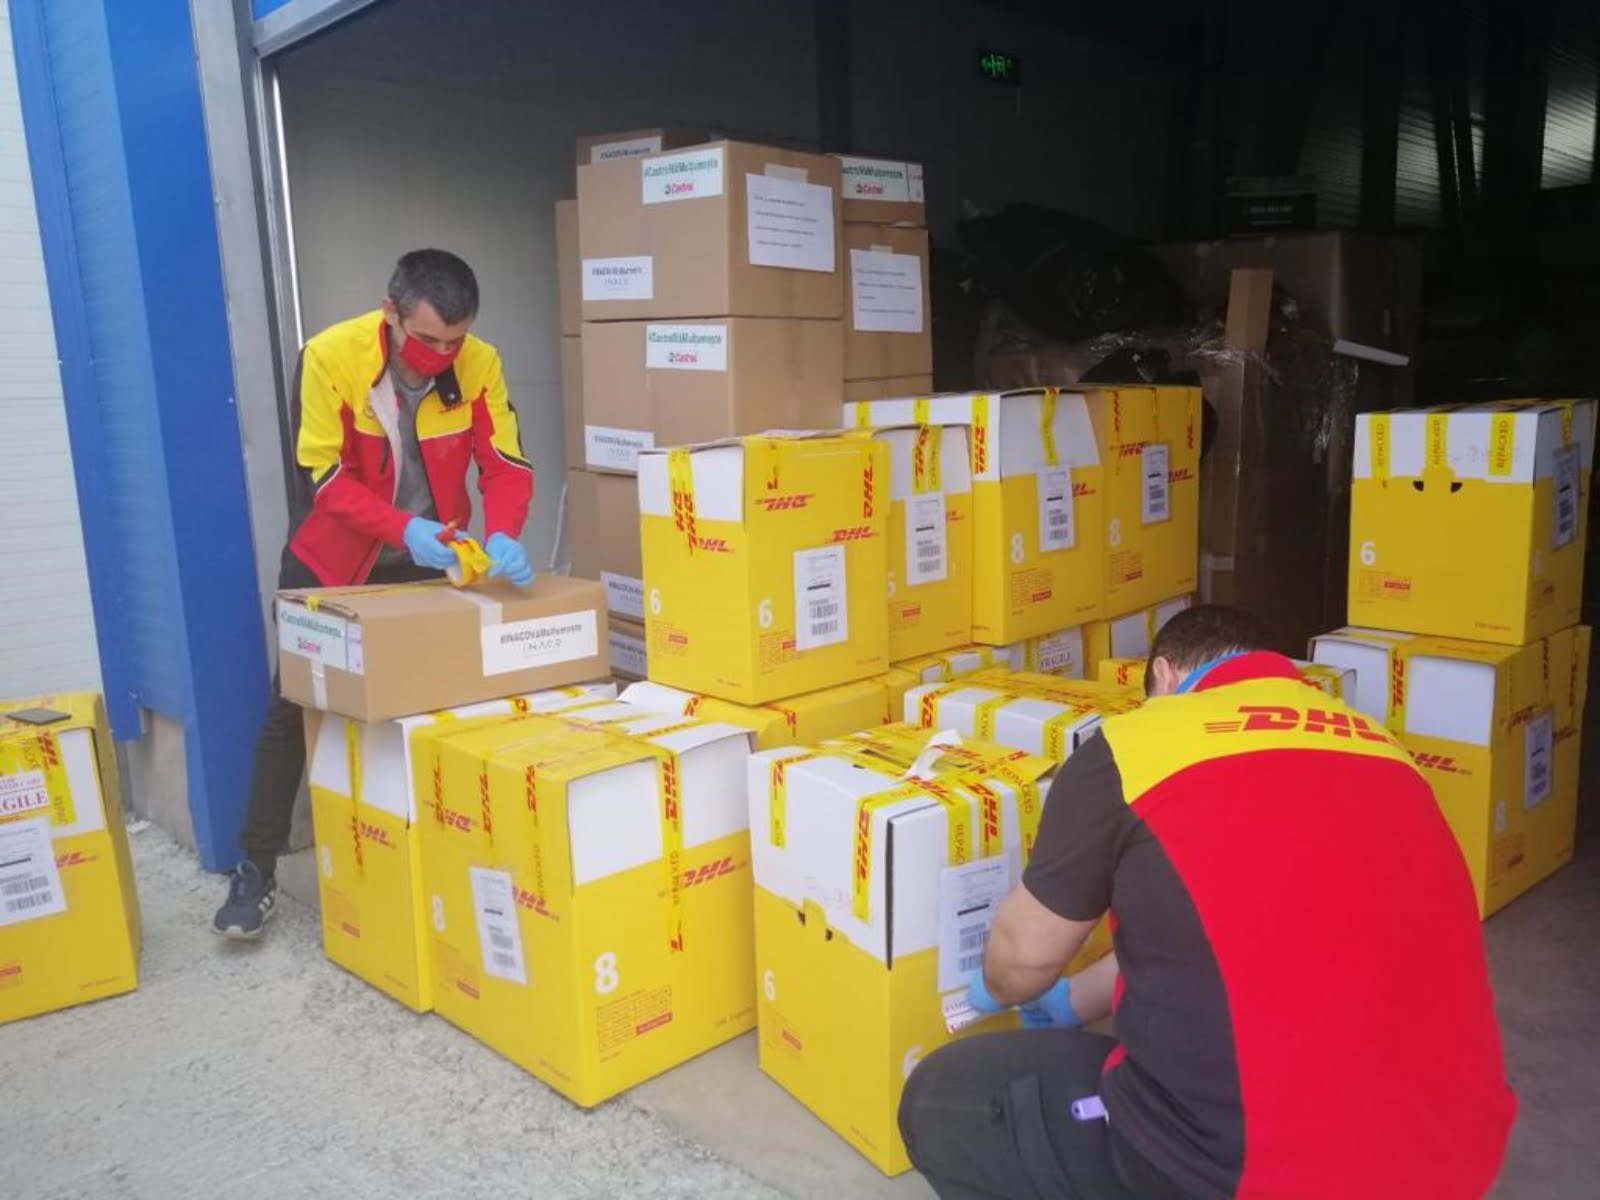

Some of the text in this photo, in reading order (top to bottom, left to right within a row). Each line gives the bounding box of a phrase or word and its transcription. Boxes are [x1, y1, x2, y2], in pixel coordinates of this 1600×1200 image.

[1497, 419, 1508, 469] REPACKED
[863, 466, 873, 519] DHL
[832, 526, 874, 542] DHL
[1011, 533, 1024, 563] 8
[1109, 518, 1121, 546] 8
[1360, 541, 1376, 566] 6
[650, 588, 662, 616] 6
[757, 599, 774, 629] 6
[1238, 706, 1389, 743] DHL
[662, 755, 677, 820] DHL
[955, 824, 965, 864] REPAC
[594, 950, 620, 995] 8
[763, 968, 776, 1001] 6
